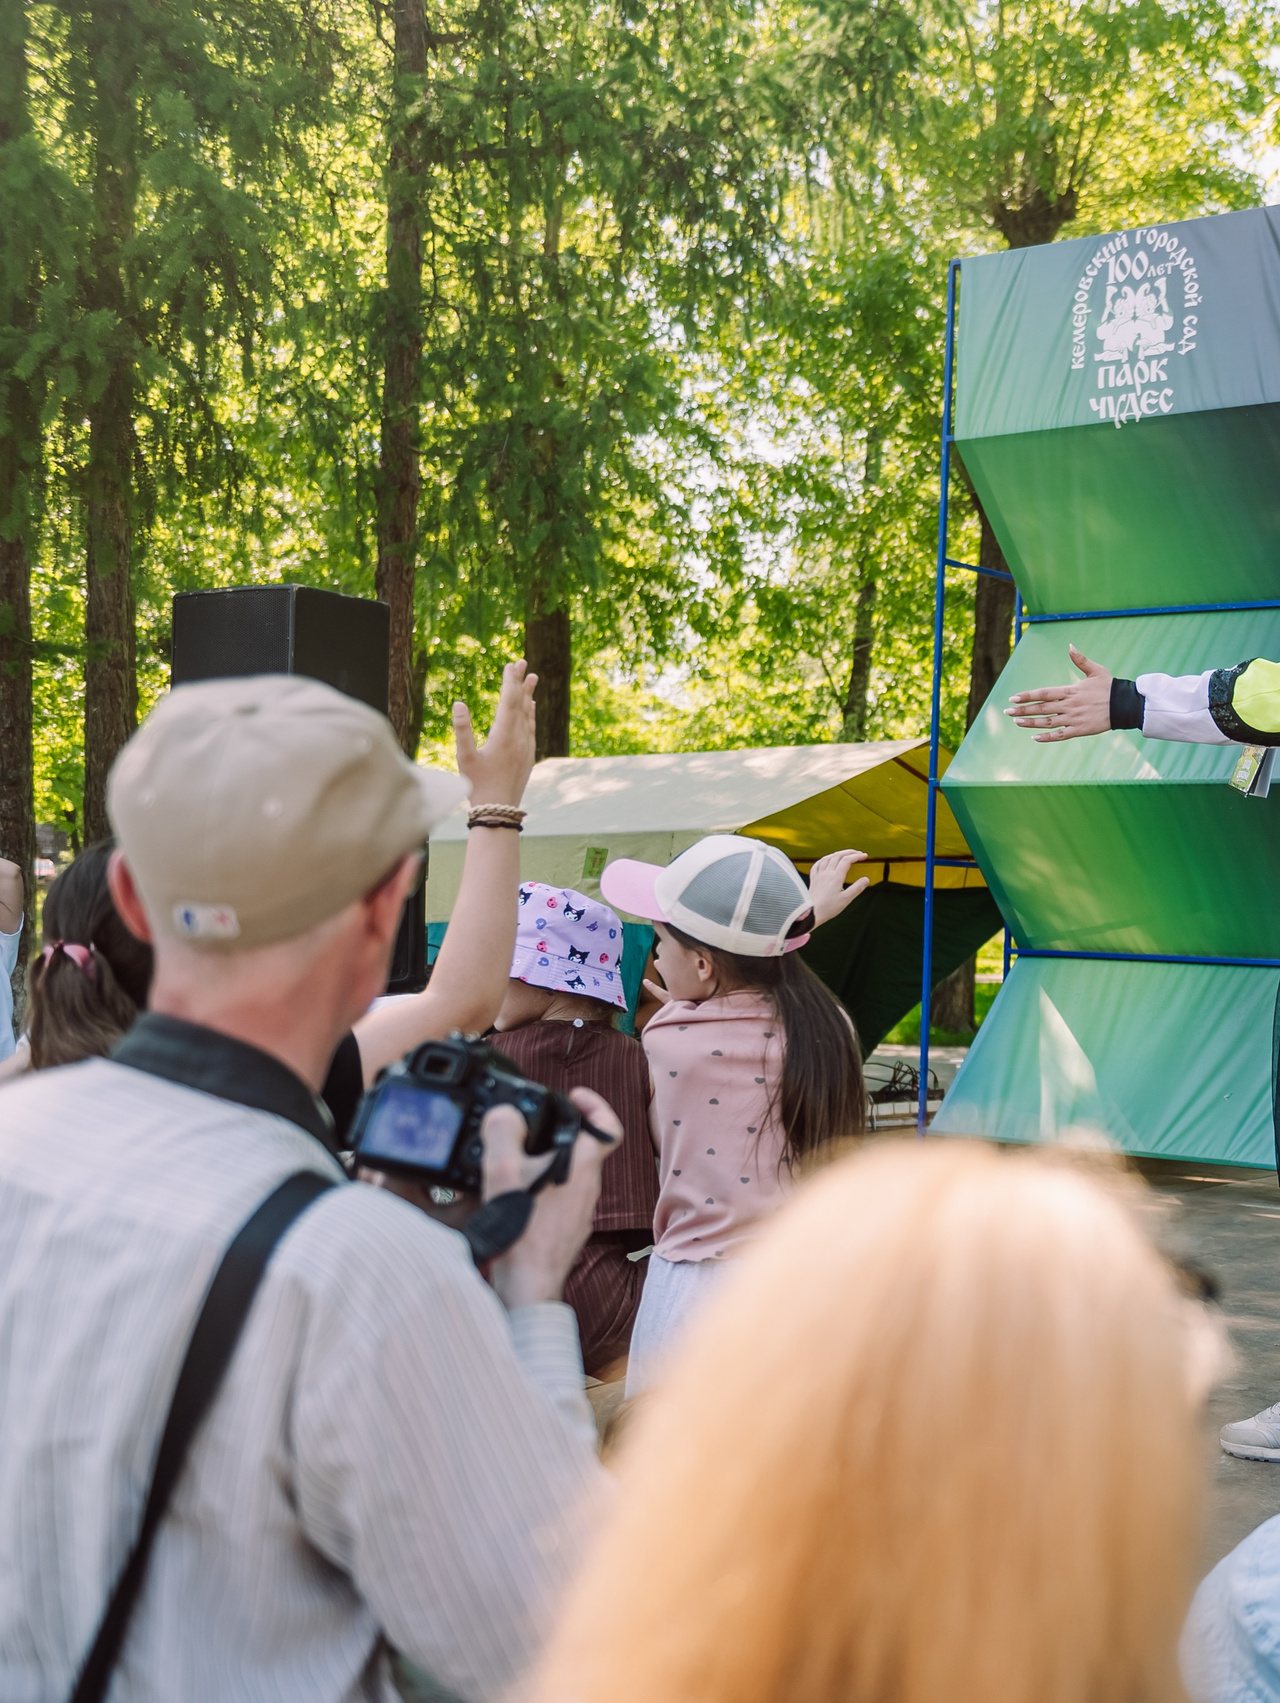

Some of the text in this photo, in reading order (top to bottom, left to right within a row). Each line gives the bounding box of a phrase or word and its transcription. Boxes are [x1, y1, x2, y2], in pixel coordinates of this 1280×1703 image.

[1105, 250, 1150, 285] 100
[1071, 228, 1202, 370] КЕМЕРОВСКИЙ ГОРОДСКОЙ САД
[1097, 357, 1169, 397] ПАРК
[1089, 387, 1175, 430] ЧУДЕС
